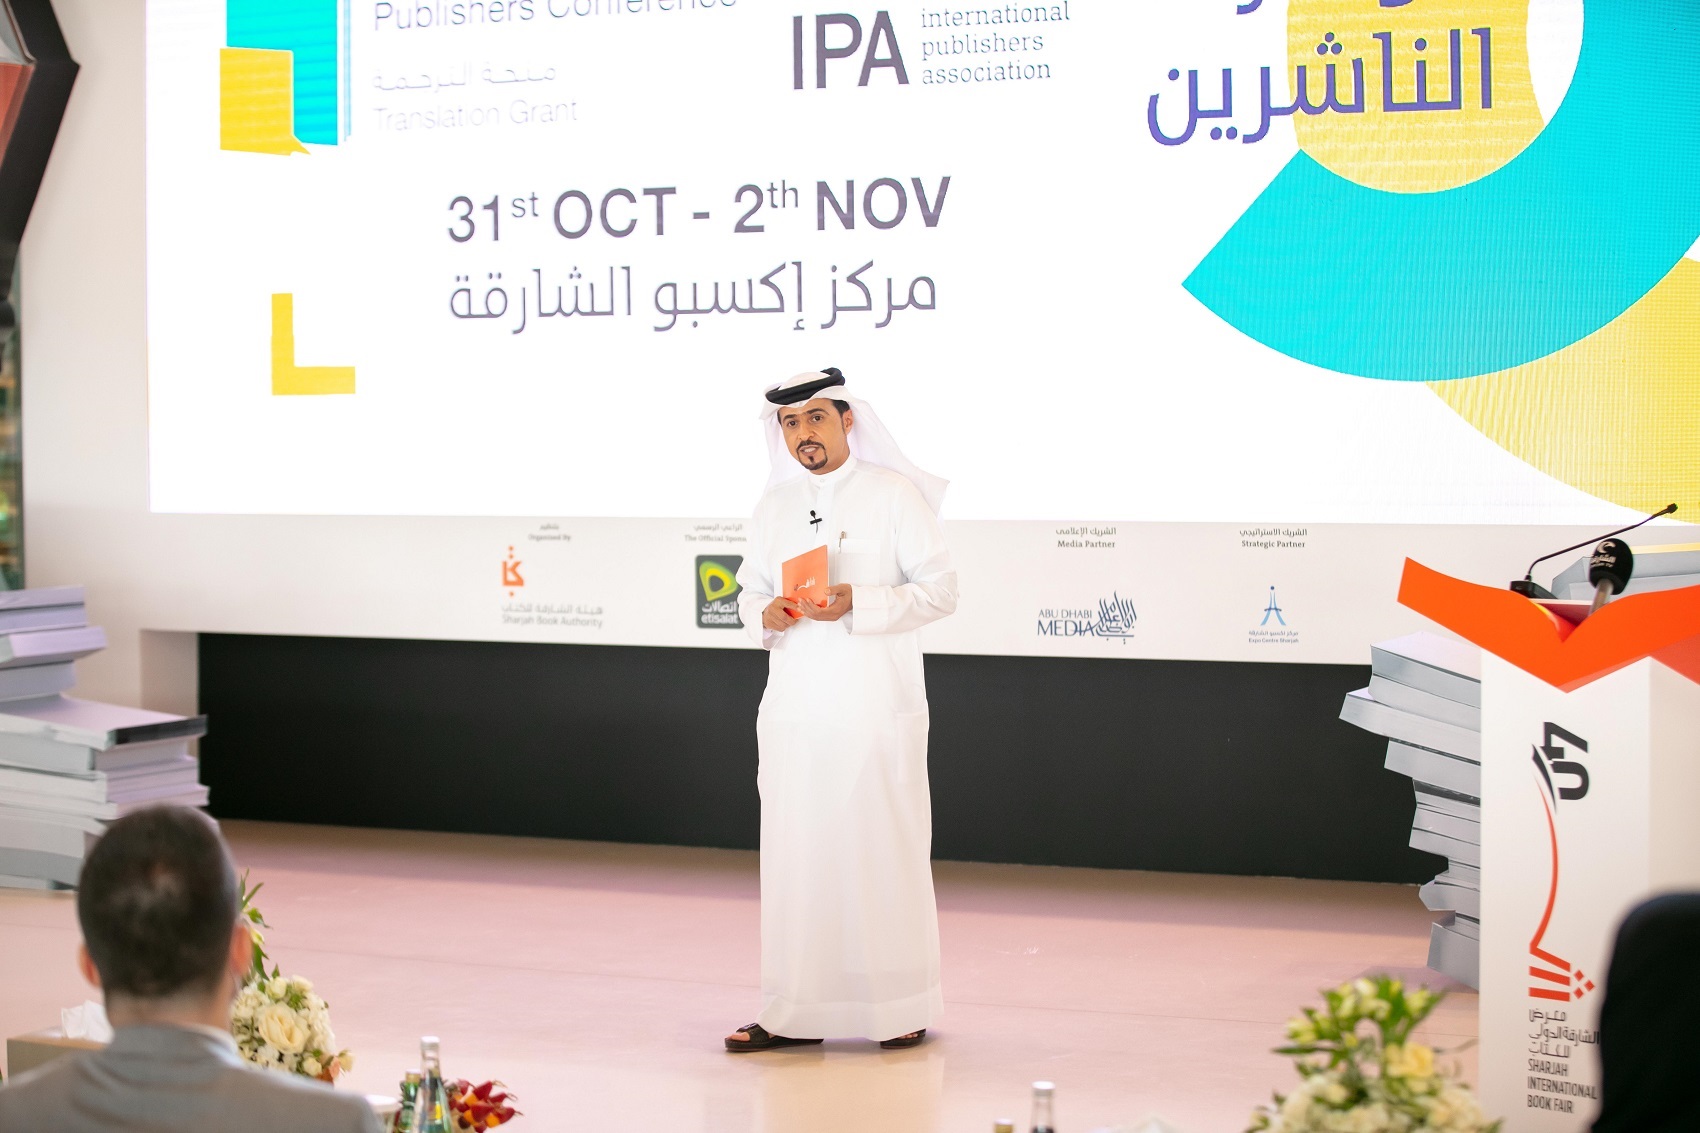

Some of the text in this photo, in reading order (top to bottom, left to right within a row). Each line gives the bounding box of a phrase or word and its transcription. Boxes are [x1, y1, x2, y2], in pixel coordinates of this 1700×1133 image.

[374, 0, 535, 31] Publishers
[920, 0, 1071, 28] international
[793, 10, 909, 90] IPA
[921, 32, 1045, 61] publishers
[922, 59, 1052, 84] association
[1147, 27, 1493, 146] الناشرين
[373, 98, 577, 131] Translation Grant
[447, 176, 951, 243] 31st OCT - 2th NOV
[449, 260, 936, 334] مركز إكسبو الشارقة
[684, 534, 697, 542] The
[698, 534, 724, 542] Official
[1090, 527, 1117, 537] الشريك
[1282, 528, 1308, 538] الشريك
[1057, 540, 1116, 548] Media Partner
[1241, 540, 1306, 550] Strategic Partner
[702, 602, 736, 614] اتصالات
[1038, 609, 1093, 619] ABU DHABI
[502, 615, 603, 629] Sharjah Book Authority
[702, 613, 739, 625] etisalat
[1037, 620, 1096, 637] MEDIA
[1528, 1008, 1566, 1024] معرض
[1562, 1021, 1600, 1046] الشارقة
[1528, 1058, 1568, 1077] SHARJAH
[1527, 1076, 1598, 1100] INTERNATIONAL
[1527, 1094, 1574, 1114] BOOK FAIR
